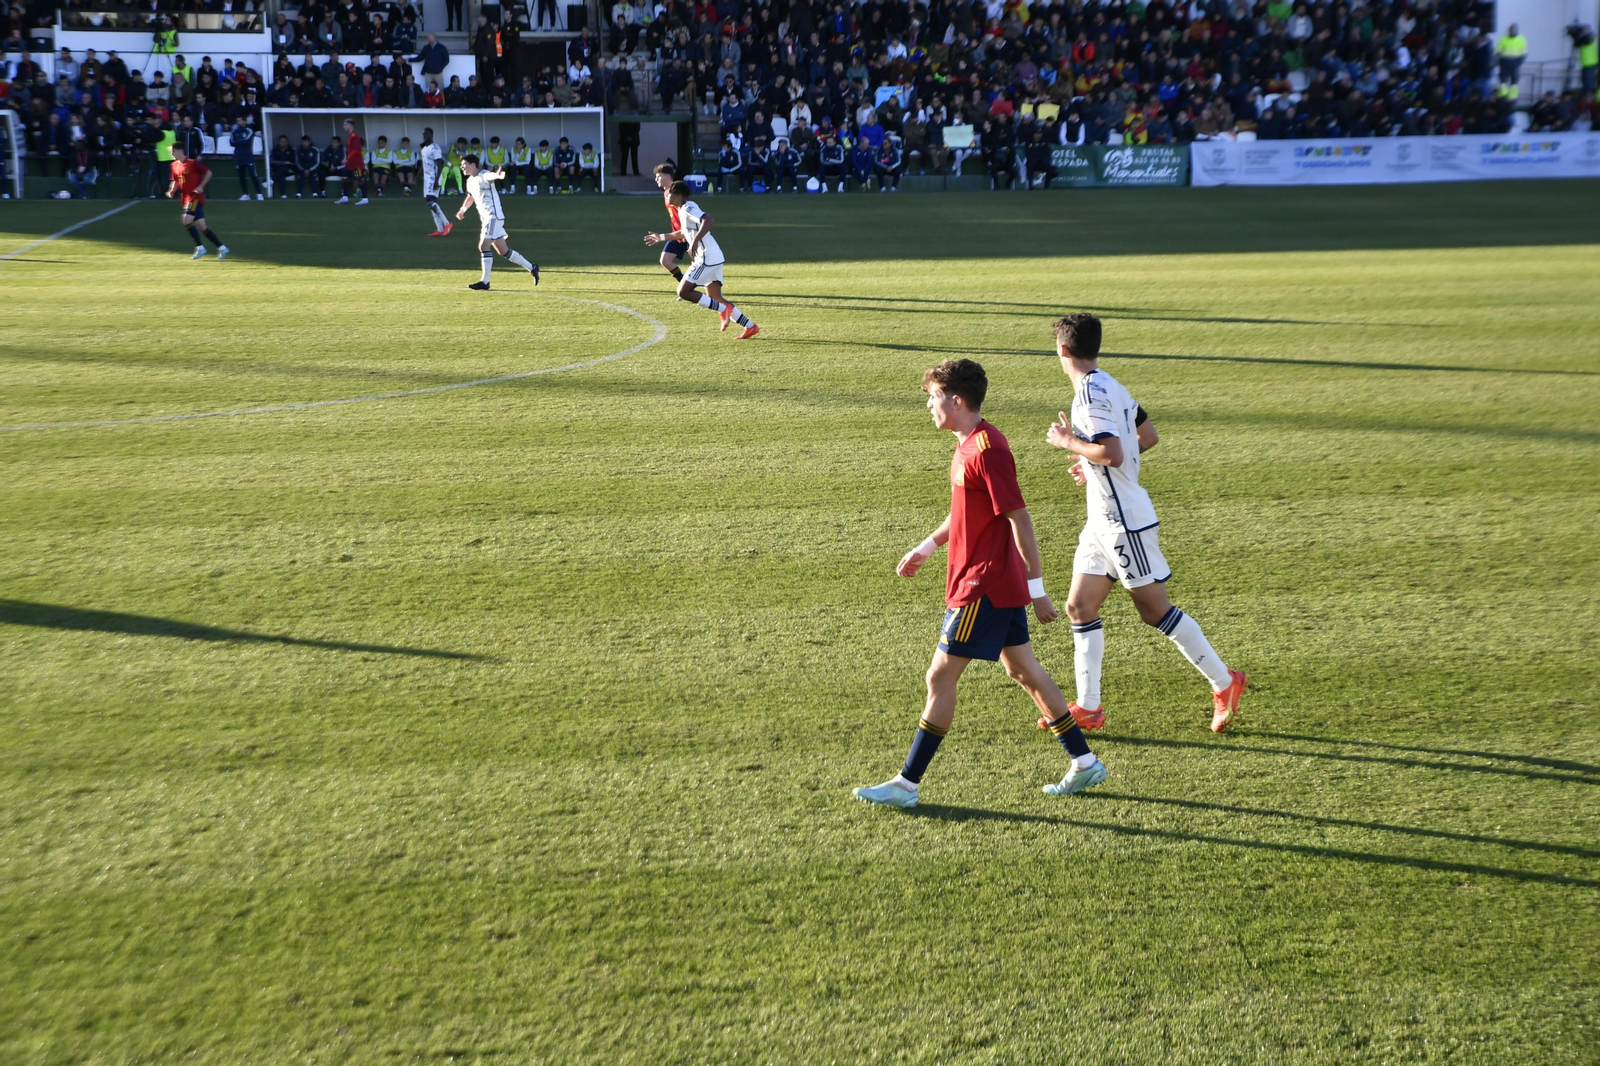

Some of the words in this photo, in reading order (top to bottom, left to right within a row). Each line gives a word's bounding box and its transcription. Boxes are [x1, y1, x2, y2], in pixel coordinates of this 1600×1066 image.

[1052, 150, 1077, 158] OTEL
[1142, 148, 1175, 156] FRUTAS
[1052, 158, 1089, 167] ESPADA
[1104, 164, 1180, 178] Manantiales
[1113, 543, 1131, 569] 3
[944, 607, 961, 628] 7
